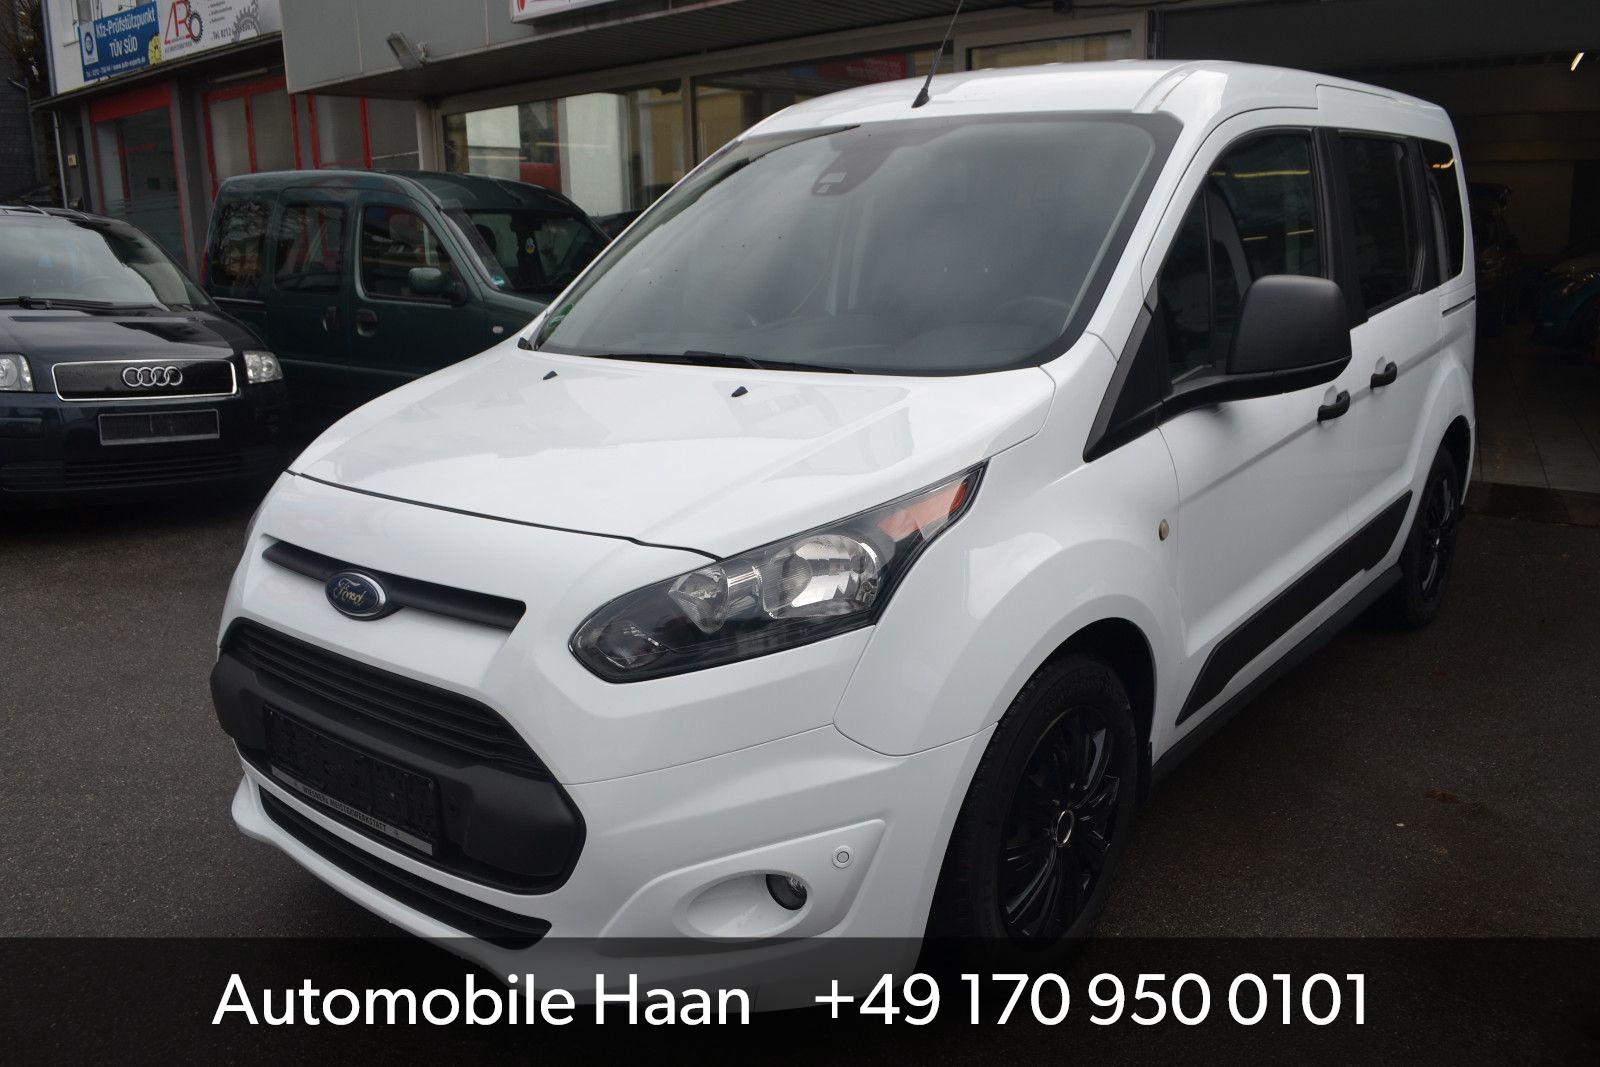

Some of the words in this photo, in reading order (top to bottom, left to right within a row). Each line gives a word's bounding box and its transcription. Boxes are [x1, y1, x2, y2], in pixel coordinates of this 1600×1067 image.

[96, 7, 156, 38] Kfz-Prüfstützpunkt
[109, 38, 123, 57] TÜV
[123, 34, 138, 55] SÜD
[333, 578, 367, 606] Ford
